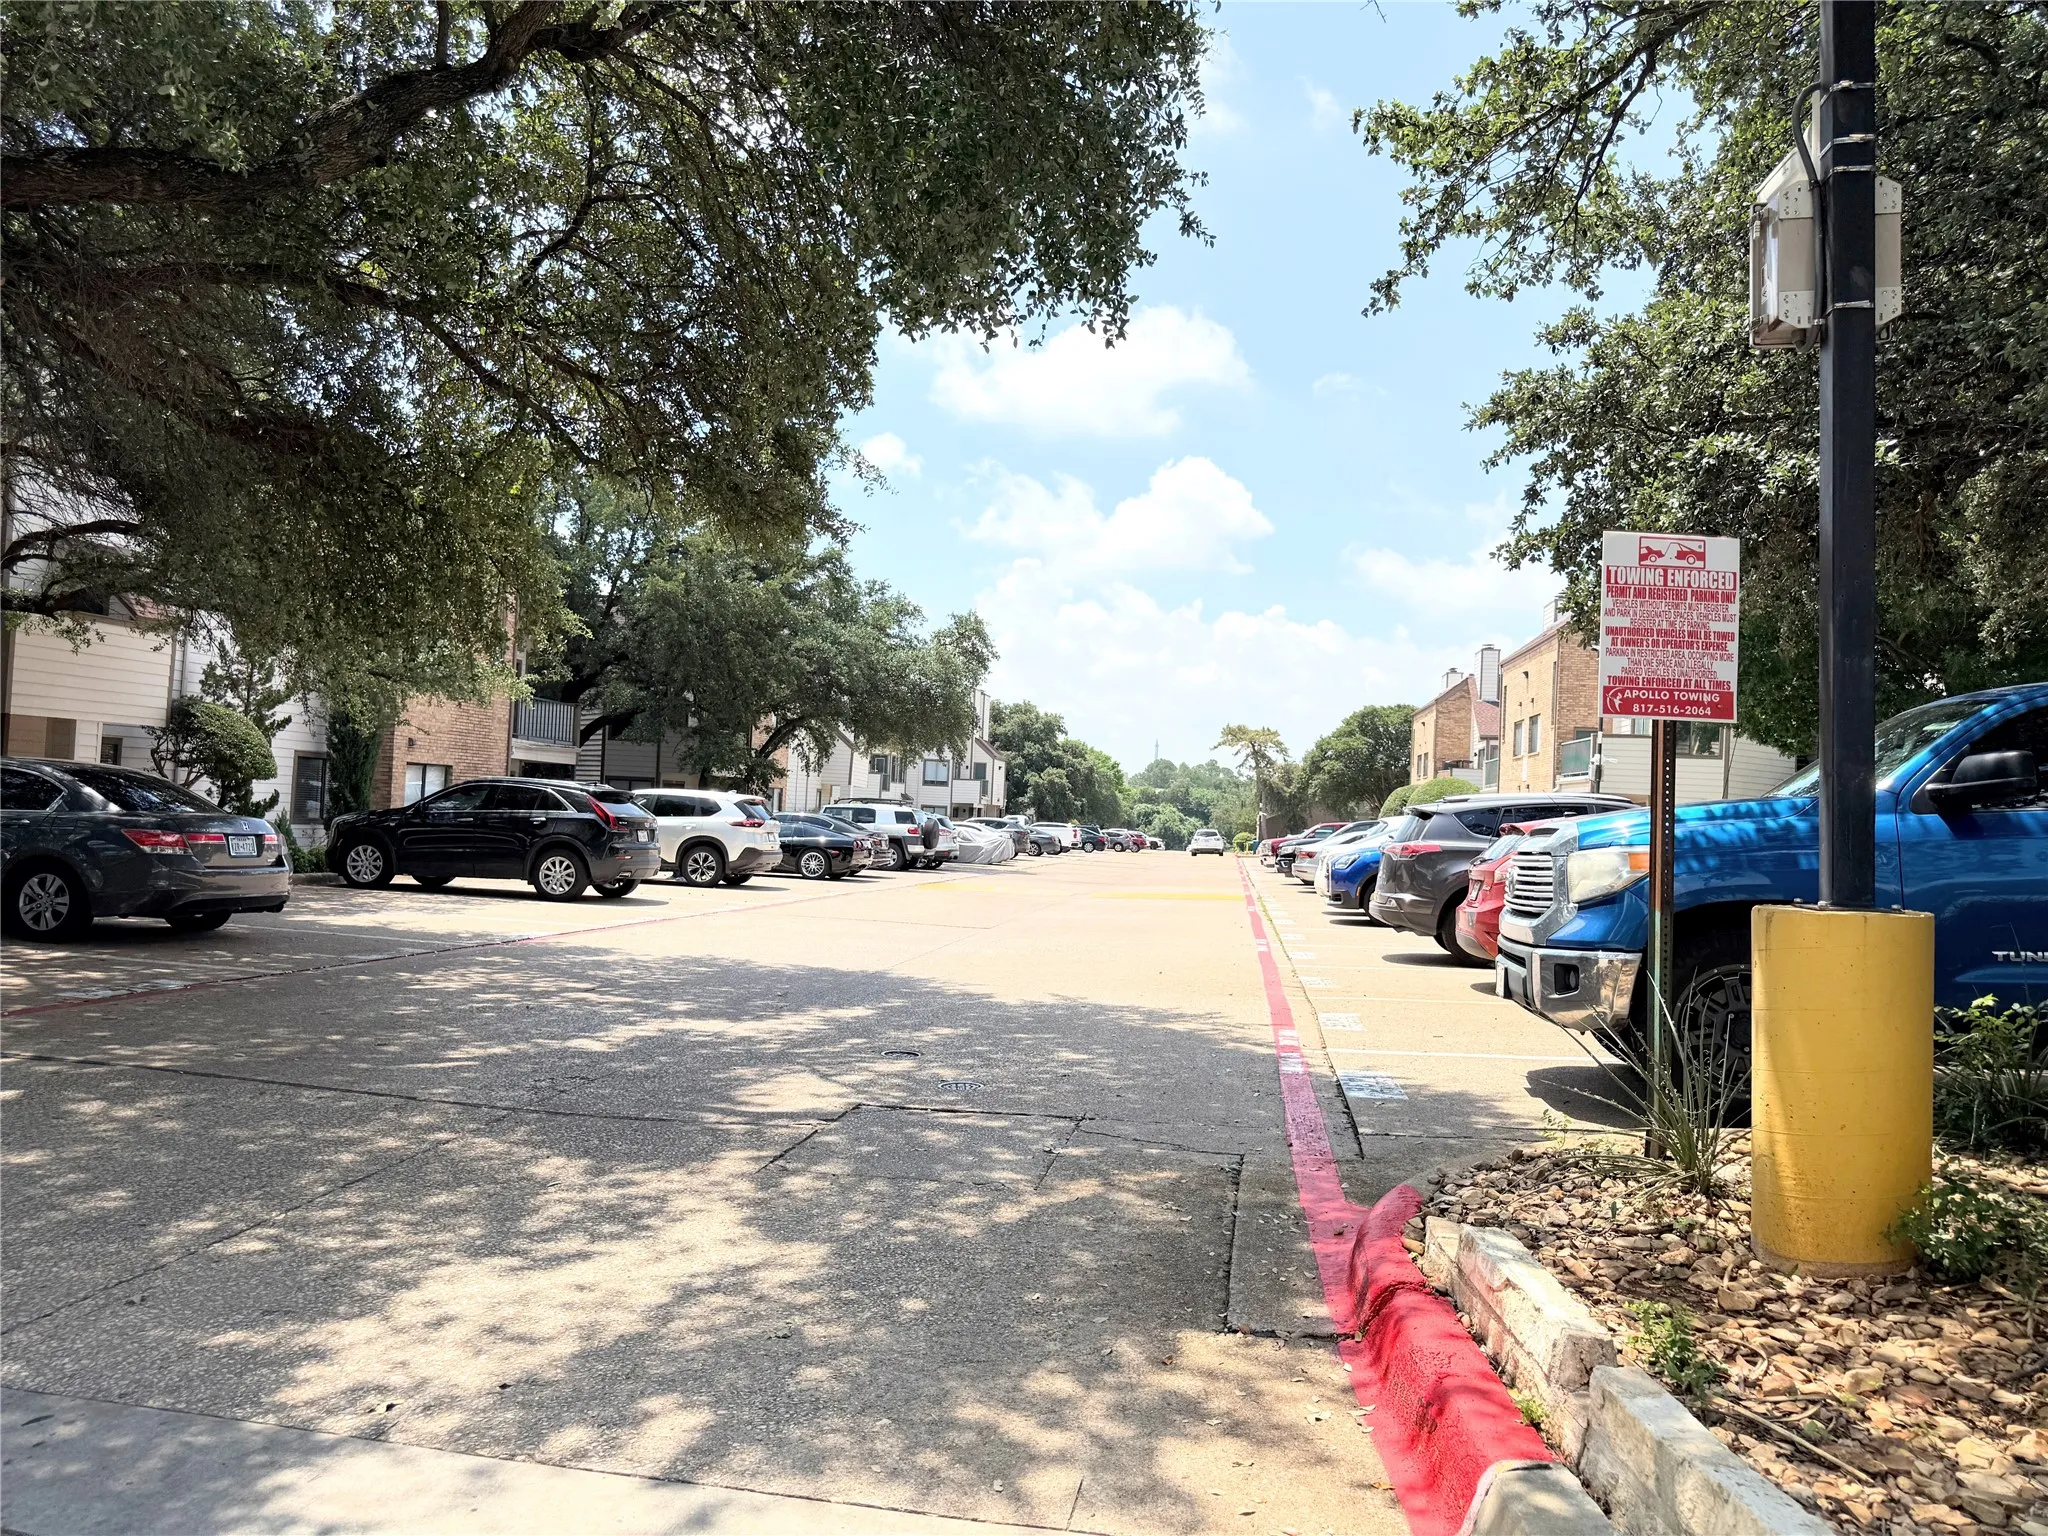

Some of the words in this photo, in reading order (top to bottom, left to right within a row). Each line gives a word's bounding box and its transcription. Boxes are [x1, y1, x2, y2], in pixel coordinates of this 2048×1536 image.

[1609, 566, 1664, 585] TOWING
[1668, 570, 1734, 589] ENFORCED
[1607, 586, 1632, 598] PERMIT
[1633, 587, 1646, 599] AND
[1648, 587, 1688, 601] REGISTERED
[1691, 590, 1719, 603] PARKING
[1721, 591, 1736, 604] ONLY
[1612, 599, 1638, 608] VEHICLES
[1639, 600, 1663, 610] WITHOUT
[1665, 602, 1687, 610] PERMITS
[1688, 603, 1703, 611] MUST
[1704, 604, 1728, 612] REGISTER
[1604, 608, 1615, 616] AND
[1617, 609, 1630, 617] PARK
[1631, 609, 1637, 617] IN
[1639, 610, 1672, 619] DESIGNATED
[1696, 612, 1721, 621] VEHICLES
[1722, 614, 1736, 622] MUST
[1630, 618, 1656, 627] REGISTER
[1657, 620, 1664, 628] AT
[1665, 620, 1677, 629] TIME
[1679, 621, 1686, 629] OF
[1606, 626, 1654, 637] UNAUTHORIZED
[1656, 628, 1686, 639] VEHICLES
[1687, 630, 1702, 640] WILL
[1704, 631, 1711, 641] BE
[1713, 631, 1734, 641] TOWED
[1611, 637, 1620, 646] AT
[1621, 638, 1650, 648] OWNER'S
[1651, 639, 1660, 648] OR
[1662, 640, 1700, 650] OPERATOR'S
[1702, 641, 1729, 652] EXPENSE.
[1606, 648, 1629, 657] PARKING
[1631, 649, 1636, 657] IN
[1637, 649, 1669, 659] RESTRICTED
[1688, 652, 1718, 661] OCCUPYING
[1720, 653, 1734, 662] MORE
[1627, 658, 1641, 666] THAN
[1643, 659, 1655, 667] ONE
[1656, 659, 1673, 668] SPACE
[1674, 660, 1685, 668] AND
[1686, 661, 1713, 669] ILLEGALLY
[1621, 667, 1642, 676] PARKED
[1644, 668, 1670, 677] VEHICLES
[1677, 669, 1718, 679] UNAUTHORIZED.
[1607, 676, 1639, 686] TOWING
[1642, 677, 1680, 688] ENFORCED
[1683, 680, 1692, 688] AT
[1694, 680, 1706, 689] ALL
[1707, 681, 1731, 690] TIMES
[1624, 690, 1669, 699] APOLLO
[1674, 692, 1719, 702] TOWING
[1633, 704, 1711, 715] 817-516-2064
[1992, 951, 2048, 962] TUN
